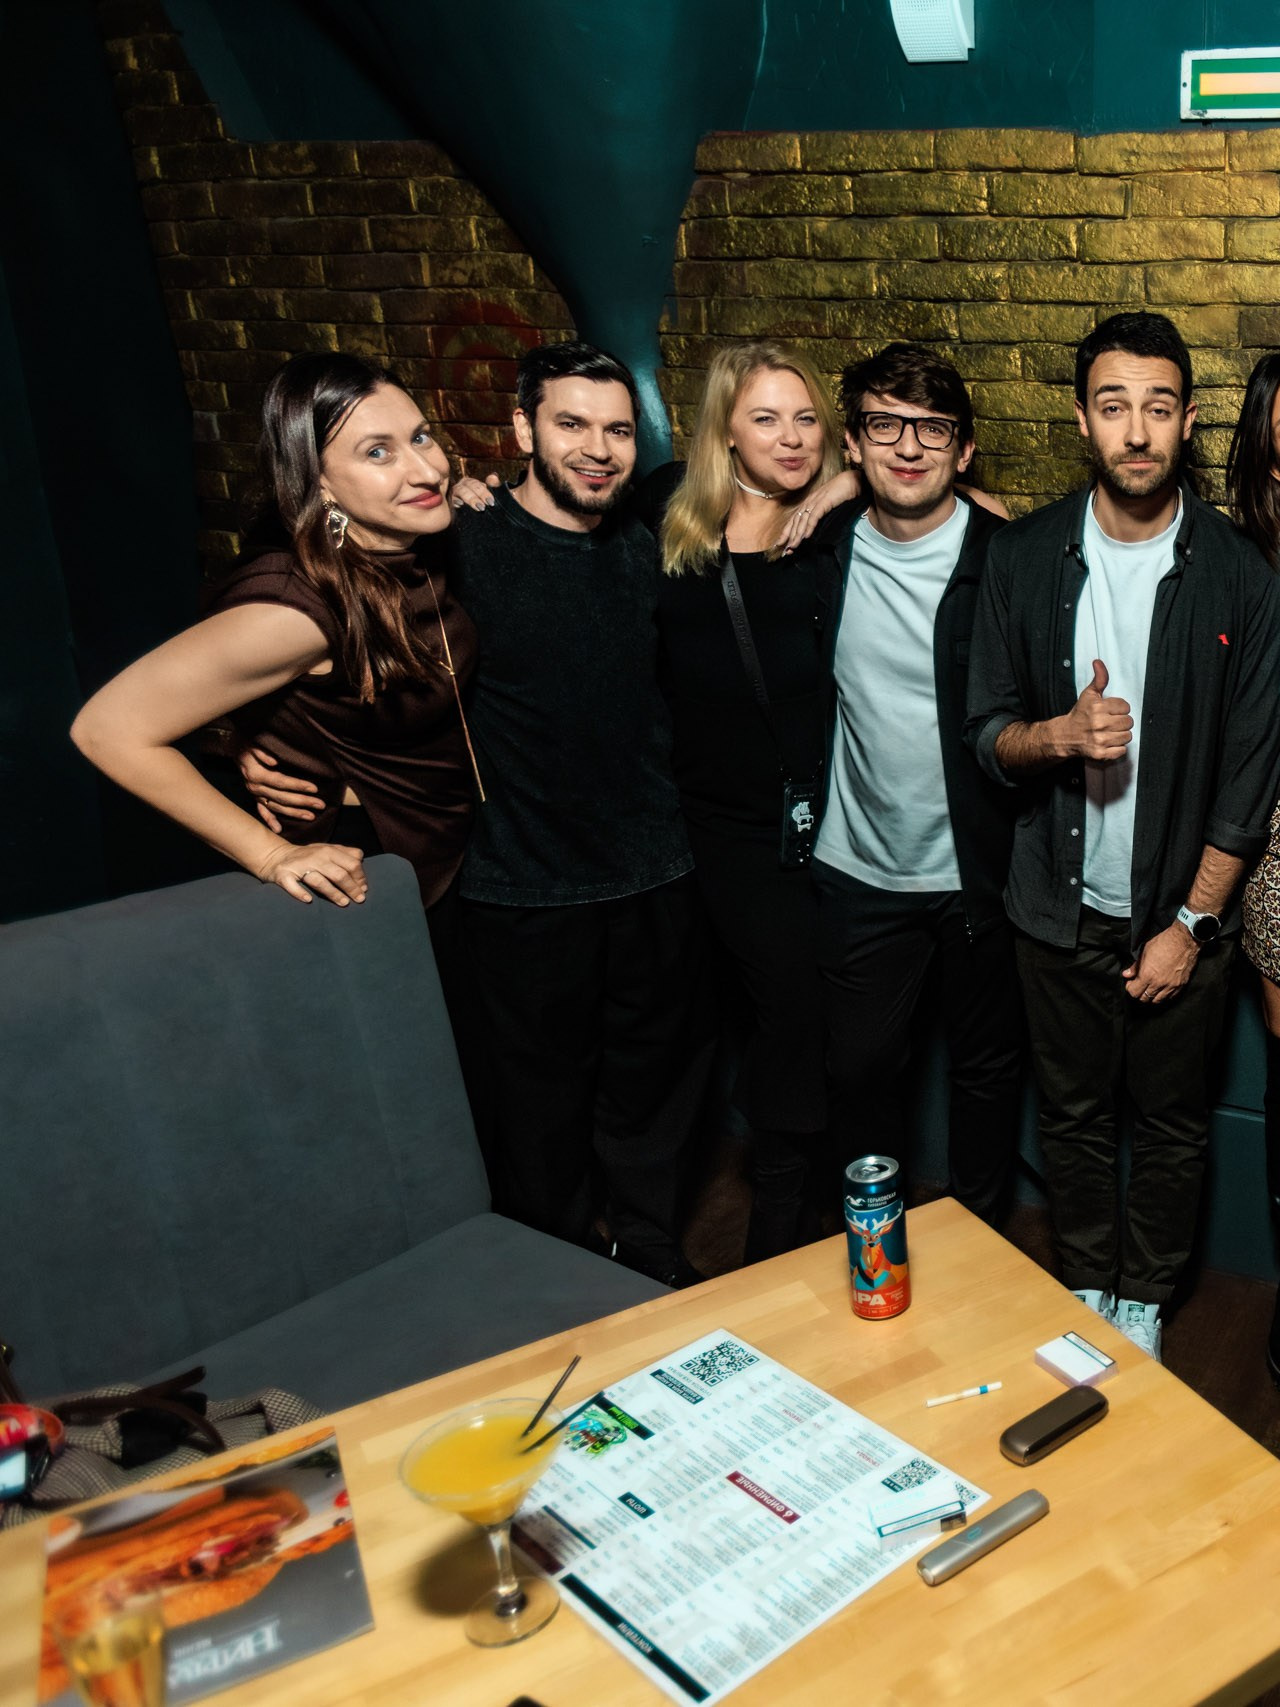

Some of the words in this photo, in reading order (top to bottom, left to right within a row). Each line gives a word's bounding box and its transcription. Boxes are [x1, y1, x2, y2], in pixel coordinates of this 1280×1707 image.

[867, 1191, 897, 1203] ГОРЬКОВСКАЯ
[852, 1290, 887, 1306] IPA
[734, 1475, 787, 1512] ФИРМЕННЫЕ
[624, 1497, 647, 1514] ШОТЫ
[615, 1621, 654, 1654] КОКТЕЙЛИ
